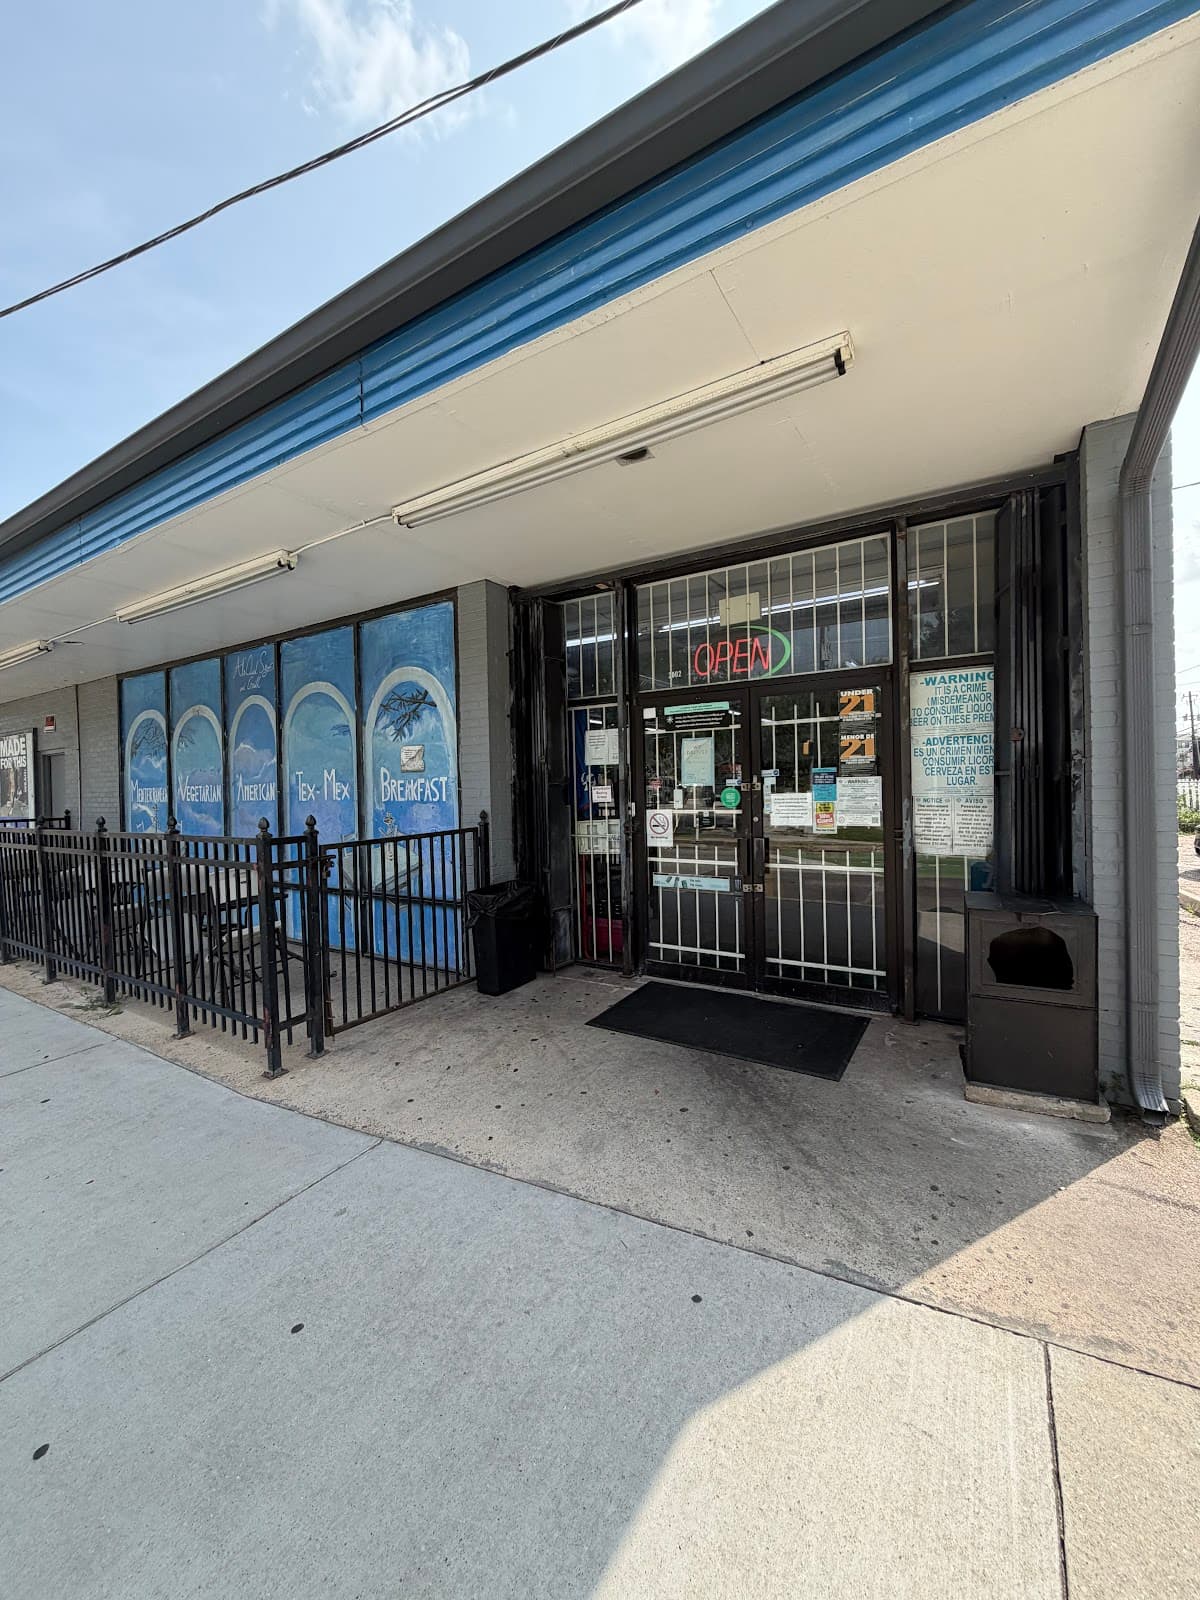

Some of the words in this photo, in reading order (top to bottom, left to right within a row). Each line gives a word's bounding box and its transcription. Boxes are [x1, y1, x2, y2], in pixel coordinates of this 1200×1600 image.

[694, 637, 771, 676] OPEN
[935, 686, 941, 695] IT
[944, 685, 951, 694] IS
[953, 685, 958, 694] A
[960, 682, 987, 693] CRIME
[839, 694, 874, 716] 21
[928, 692, 992, 706] (MISDEMEANOR
[912, 708, 922, 716] TO
[924, 705, 964, 716] CONSUME
[966, 703, 994, 713] LIQUO
[930, 716, 942, 725] ON
[944, 714, 970, 724] THESE
[0, 737, 26, 757] MADE
[922, 734, 994, 746] -ADVERTENCI
[840, 738, 874, 760] 21
[914, 748, 924, 757] ES
[926, 747, 937, 756] UN
[940, 745, 971, 756] CRIMEN
[0, 758, 12, 770] FOR
[13, 756, 26, 768] THIS
[922, 757, 966, 766] CONSUMIR
[969, 756, 994, 765] LICOR
[925, 767, 963, 776] CERVEZA
[965, 766, 976, 775] EN
[237, 774, 276, 801] AMERICAN
[380, 766, 448, 802] BREAKFAST
[947, 776, 978, 785] LUGAR.
[178, 776, 222, 802] VEGETARIAN
